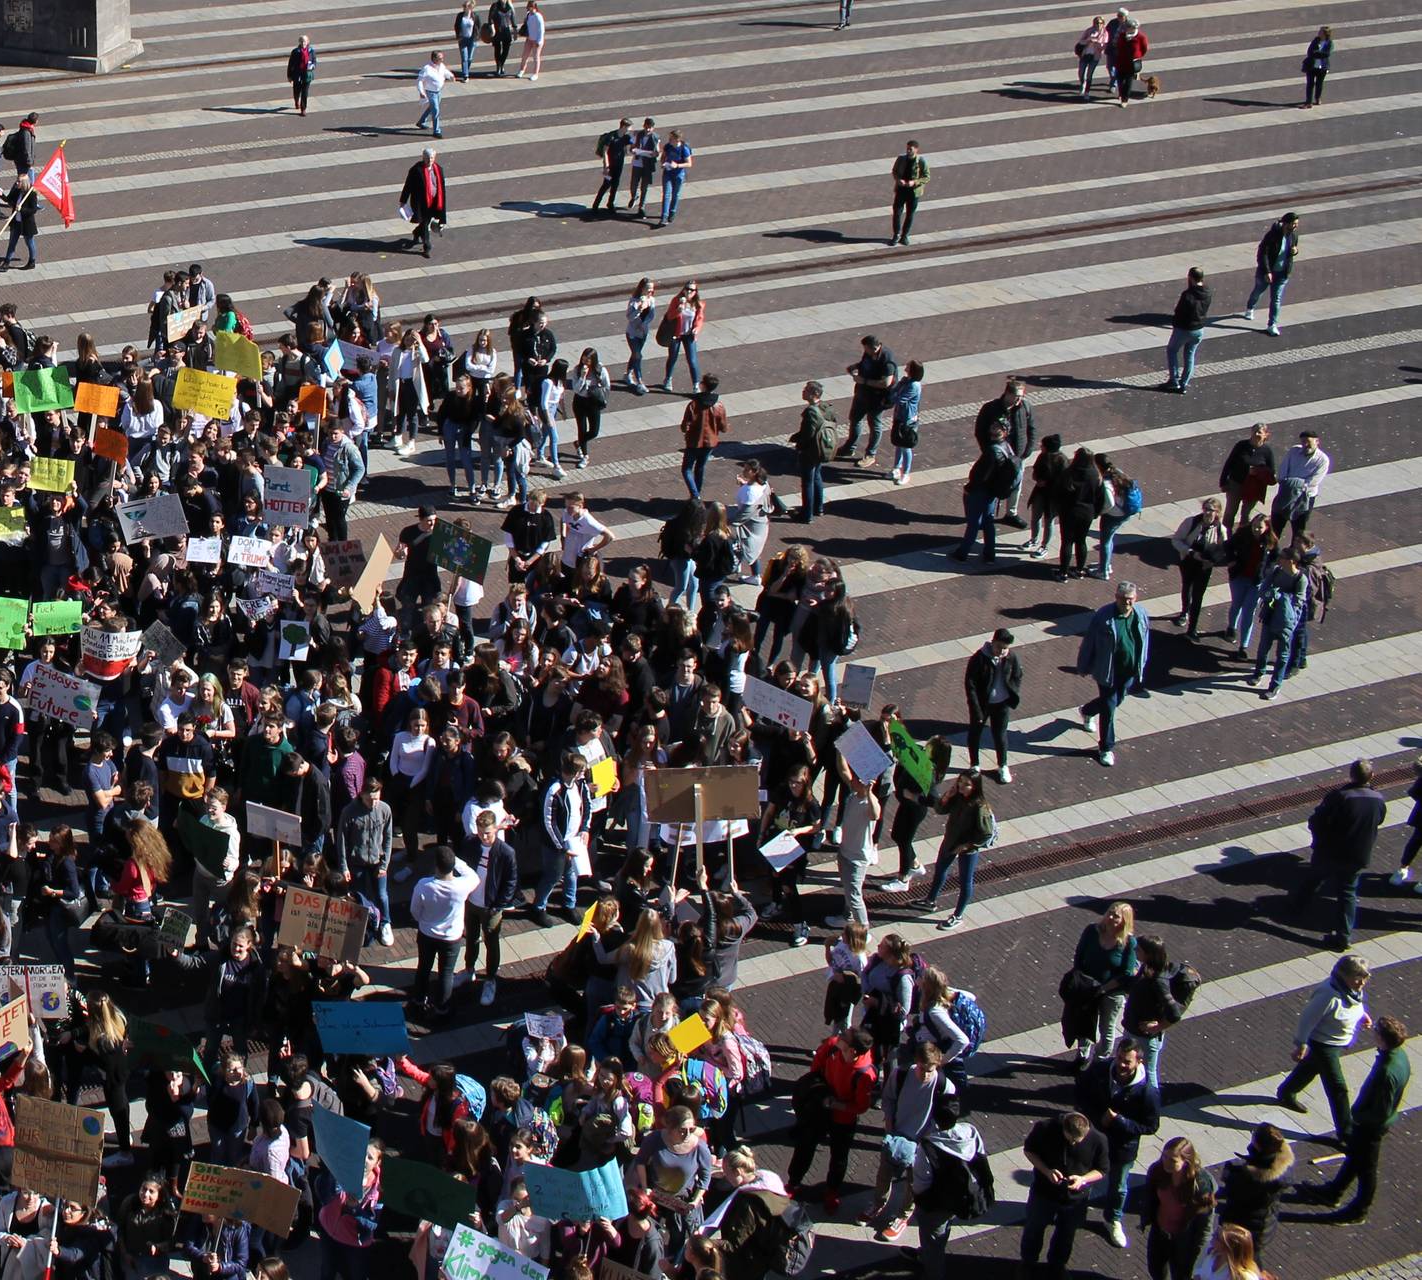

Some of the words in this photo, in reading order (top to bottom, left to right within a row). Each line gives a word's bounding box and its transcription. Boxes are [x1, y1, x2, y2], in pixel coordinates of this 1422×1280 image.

[264, 499, 306, 513] HOTTER
[237, 537, 263, 548] DON'T
[35, 603, 55, 613] Fuck
[99, 633, 110, 644] 11
[33, 677, 47, 689] for
[35, 665, 79, 690] Fridays
[29, 692, 79, 720] Future
[293, 892, 320, 909] DAS
[328, 901, 364, 921] KLIMA
[27, 965, 65, 975] MORGEN
[19, 1128, 42, 1144] IHR
[48, 1134, 95, 1156] HEUTE
[195, 1164, 222, 1175] DIE
[191, 1173, 245, 1187] ZUKUNFT
[186, 1198, 219, 1209] HAND
[475, 1242, 516, 1267] gegen
